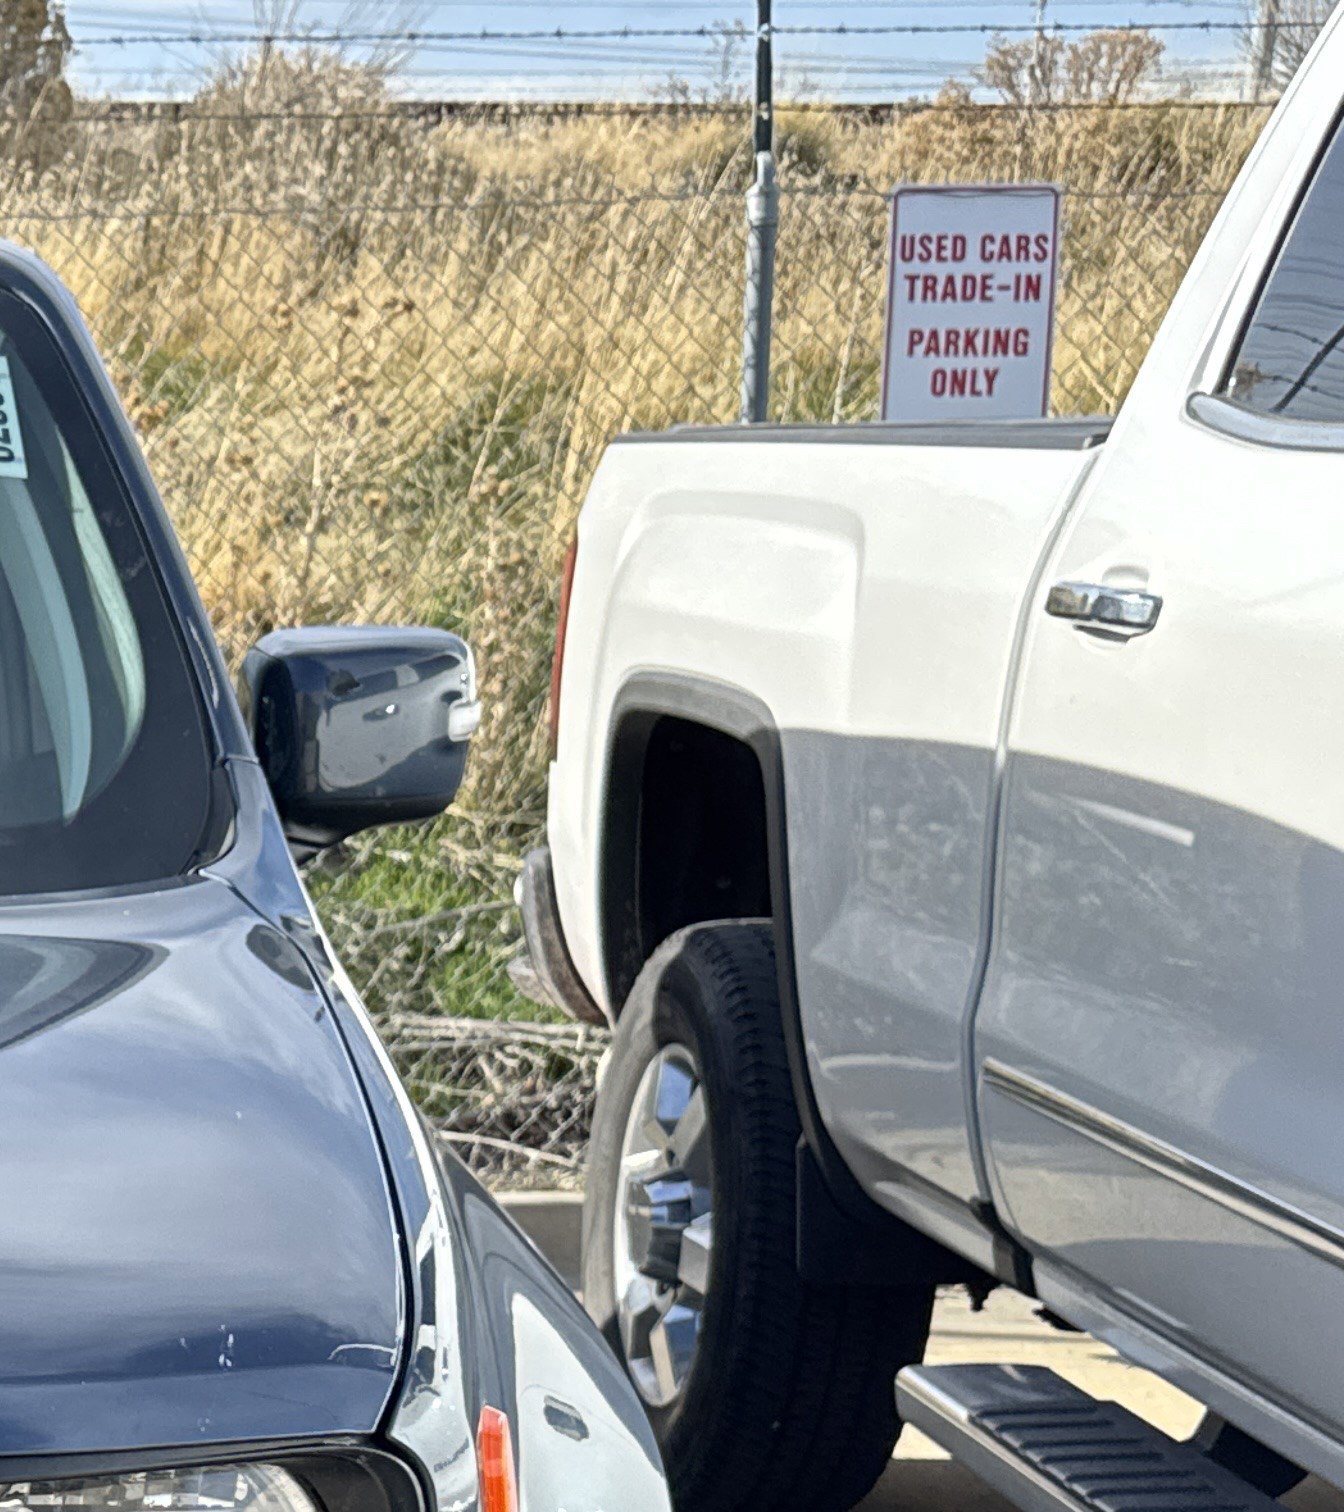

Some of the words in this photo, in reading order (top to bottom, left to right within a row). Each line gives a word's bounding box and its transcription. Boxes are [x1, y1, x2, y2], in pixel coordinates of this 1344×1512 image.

[900, 233, 967, 263] USED
[979, 233, 1049, 263] CARS
[904, 273, 1042, 303] TRADE-IN
[906, 327, 1030, 358] PARKING
[930, 367, 1000, 398] ONLY
